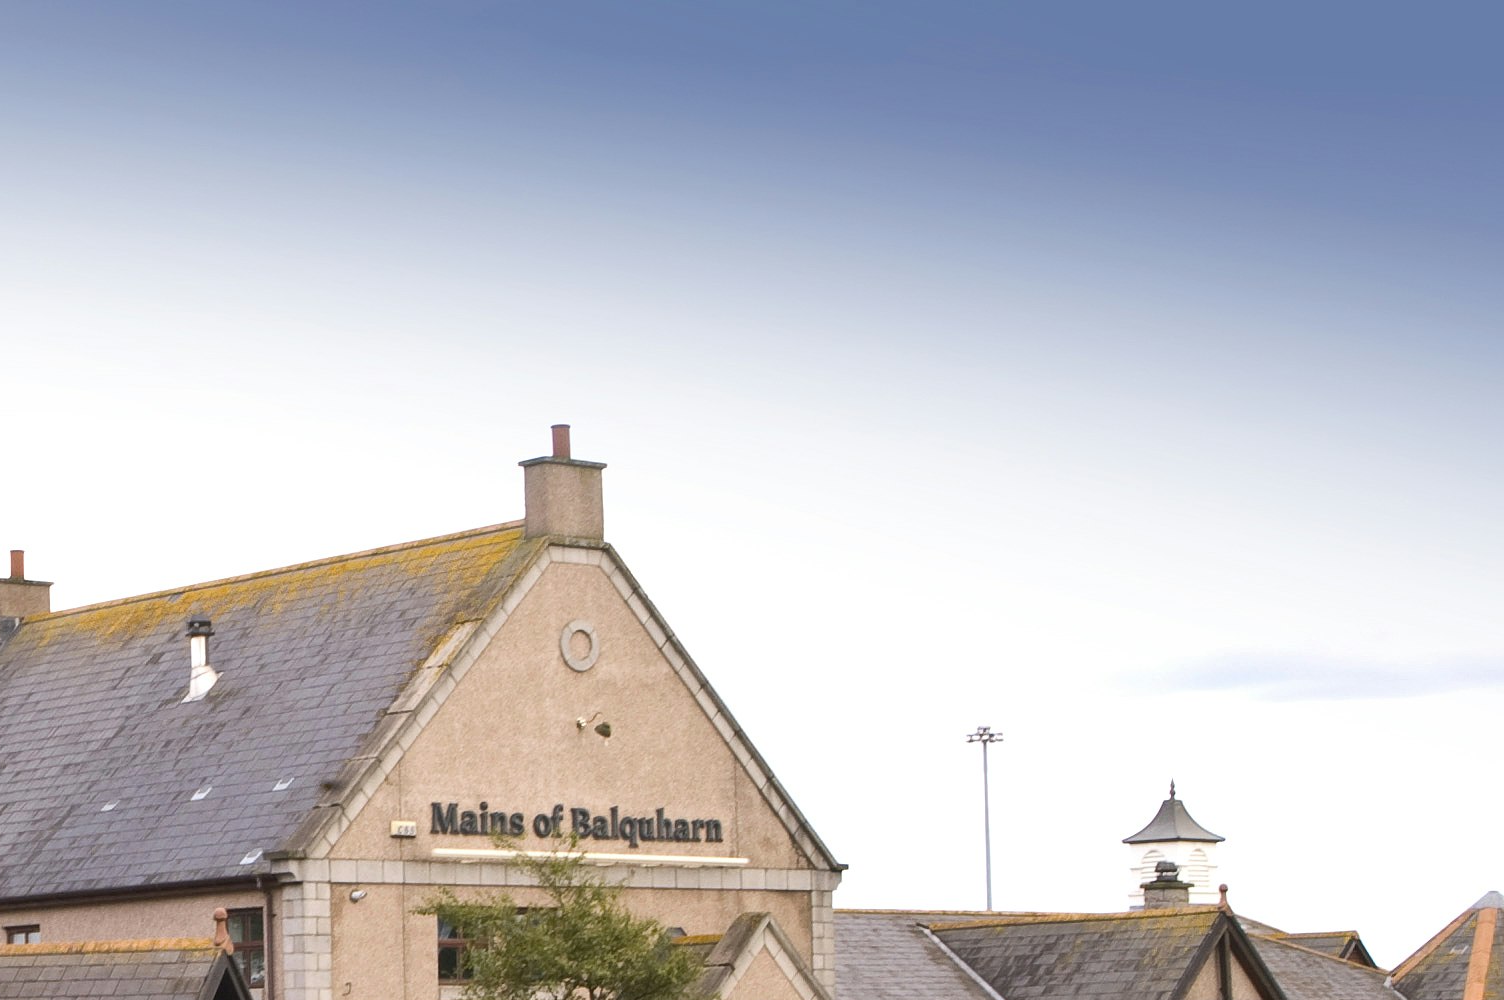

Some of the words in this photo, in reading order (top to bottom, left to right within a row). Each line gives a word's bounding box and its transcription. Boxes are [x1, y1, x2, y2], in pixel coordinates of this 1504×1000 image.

[430, 801, 525, 837] Mains
[533, 803, 565, 839] of
[570, 805, 724, 848] Balquharn
